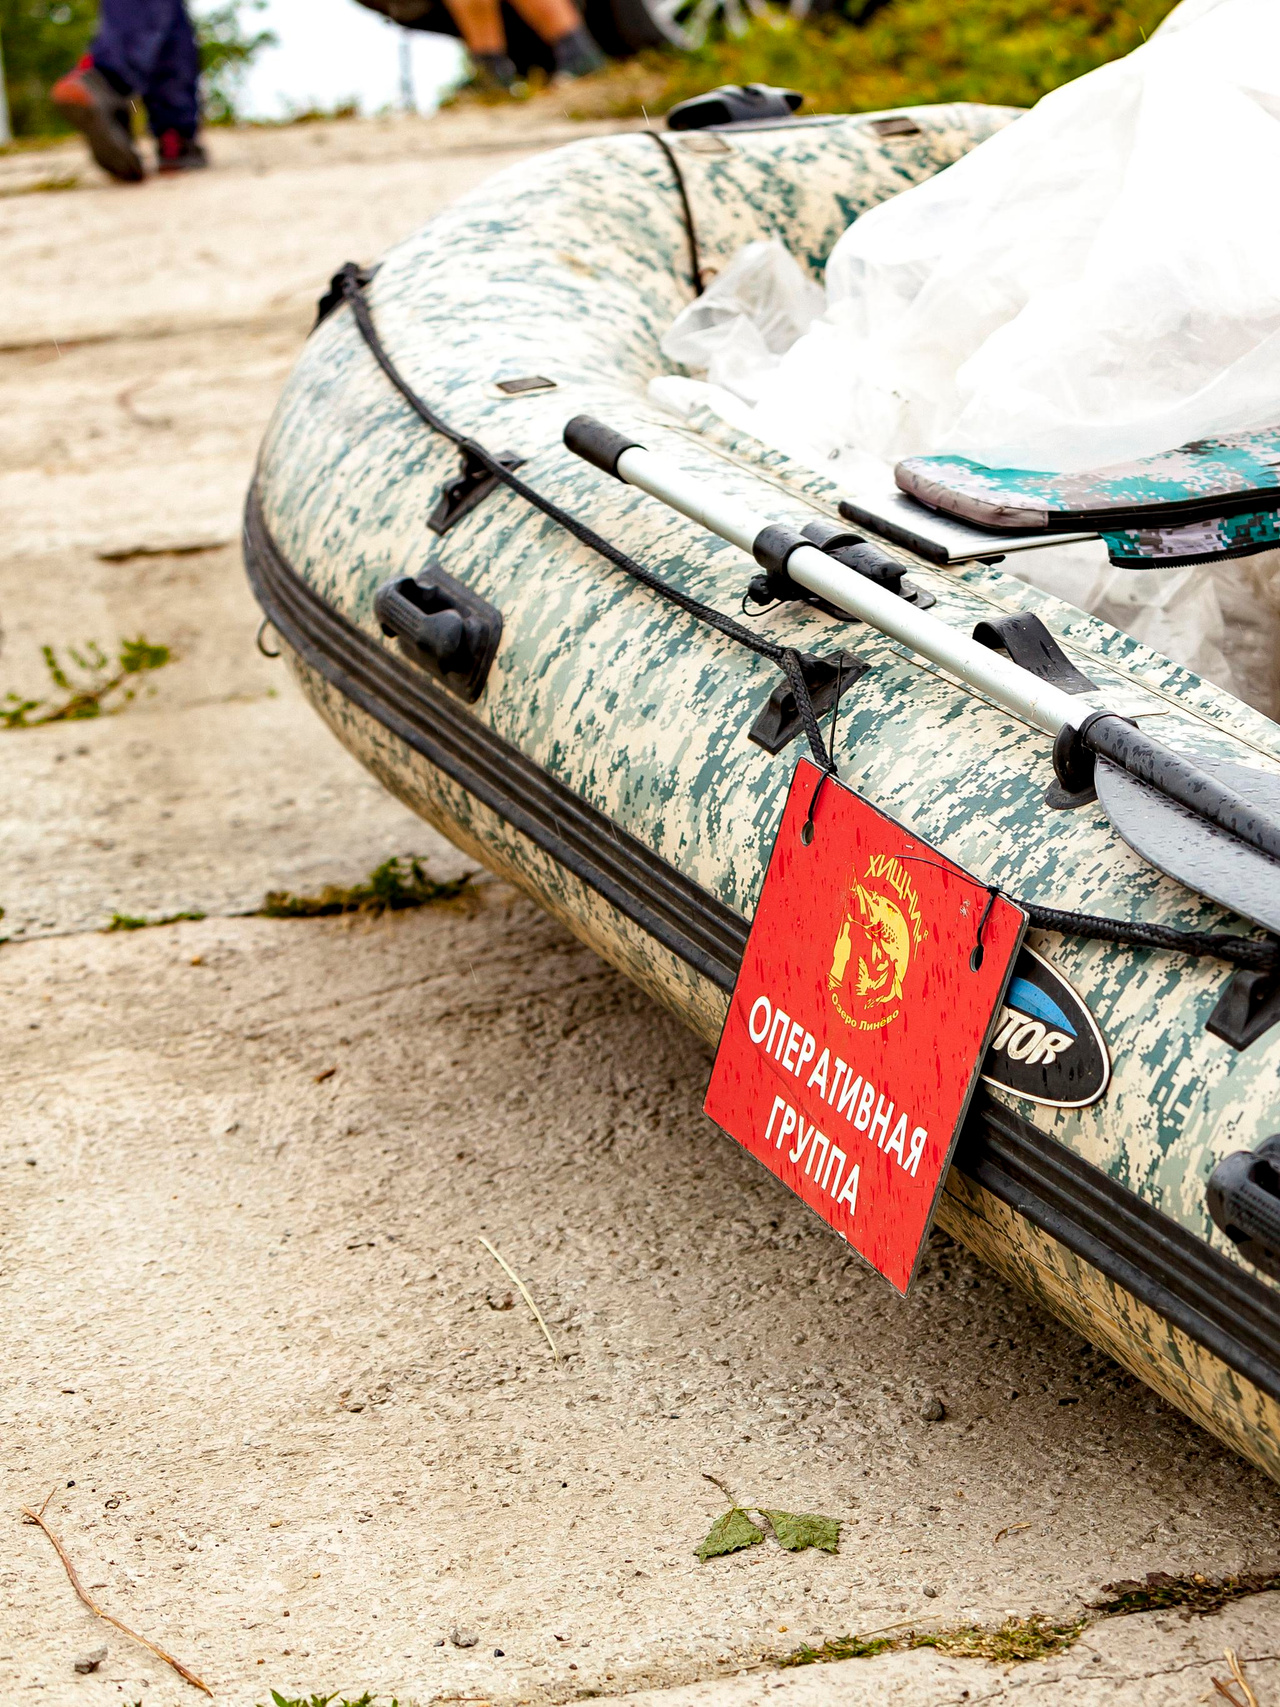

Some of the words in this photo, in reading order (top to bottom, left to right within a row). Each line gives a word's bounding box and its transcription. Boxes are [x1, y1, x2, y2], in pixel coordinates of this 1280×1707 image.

[831, 992, 857, 1028] Озеро
[859, 1009, 899, 1031] Линёво
[749, 995, 928, 1178] ОПЕРАТИВНАЯ
[765, 1095, 861, 1216] ГРУППА
